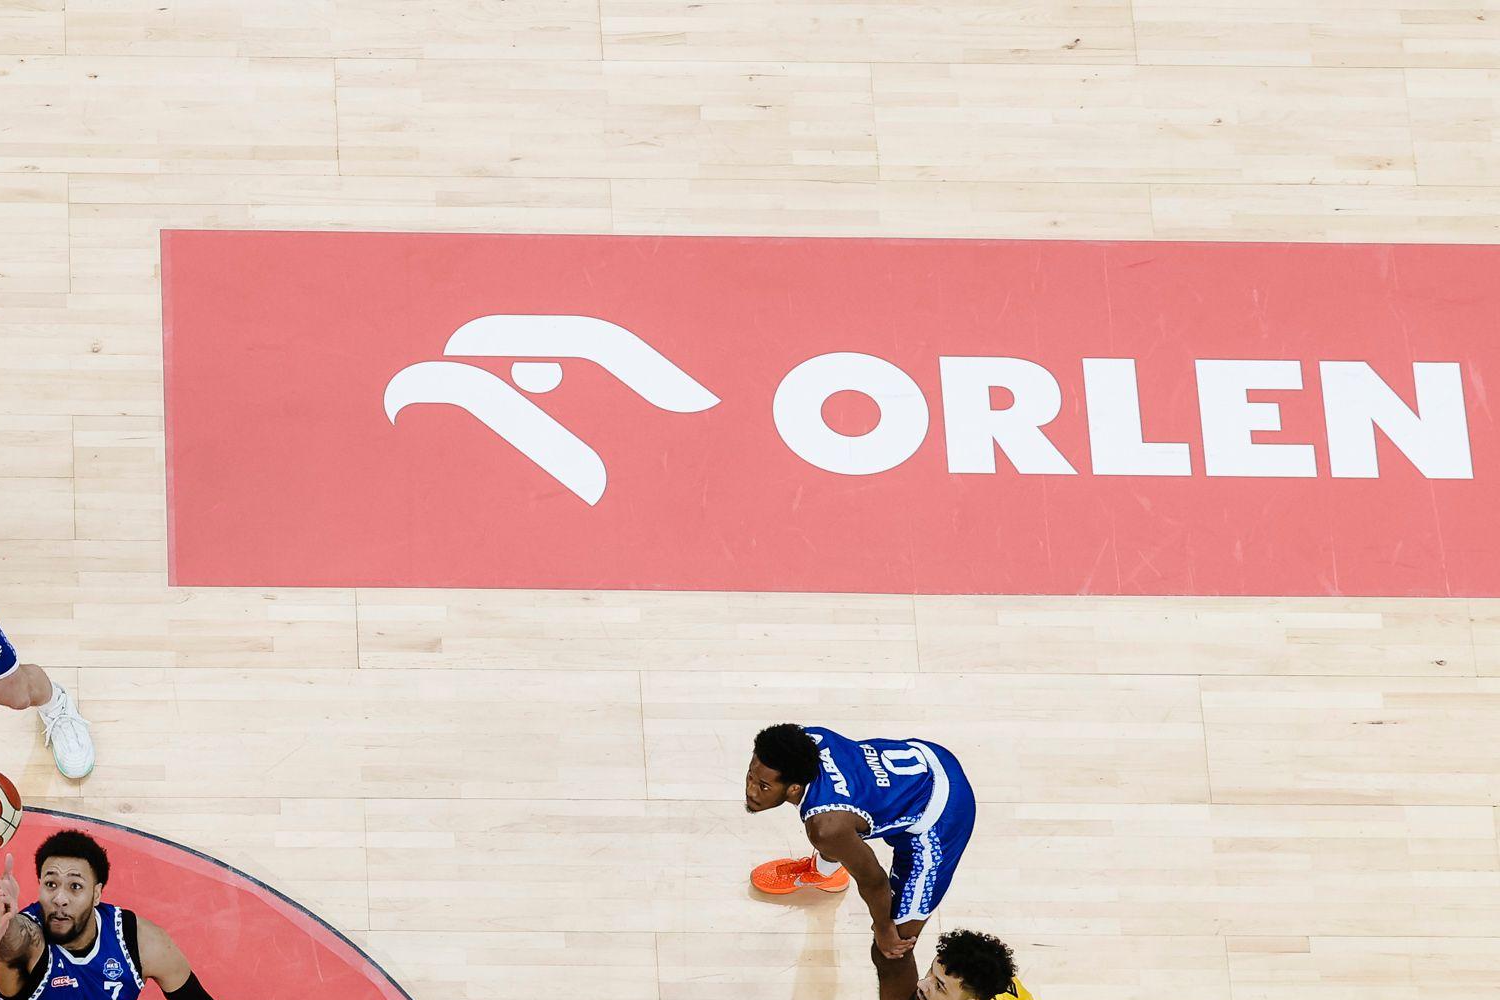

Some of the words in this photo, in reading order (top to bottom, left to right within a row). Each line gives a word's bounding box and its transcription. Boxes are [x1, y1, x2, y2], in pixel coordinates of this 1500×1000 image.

[773, 353, 1473, 479] ORLEN
[819, 746, 851, 798] ALBA
[880, 747, 929, 776] 0
